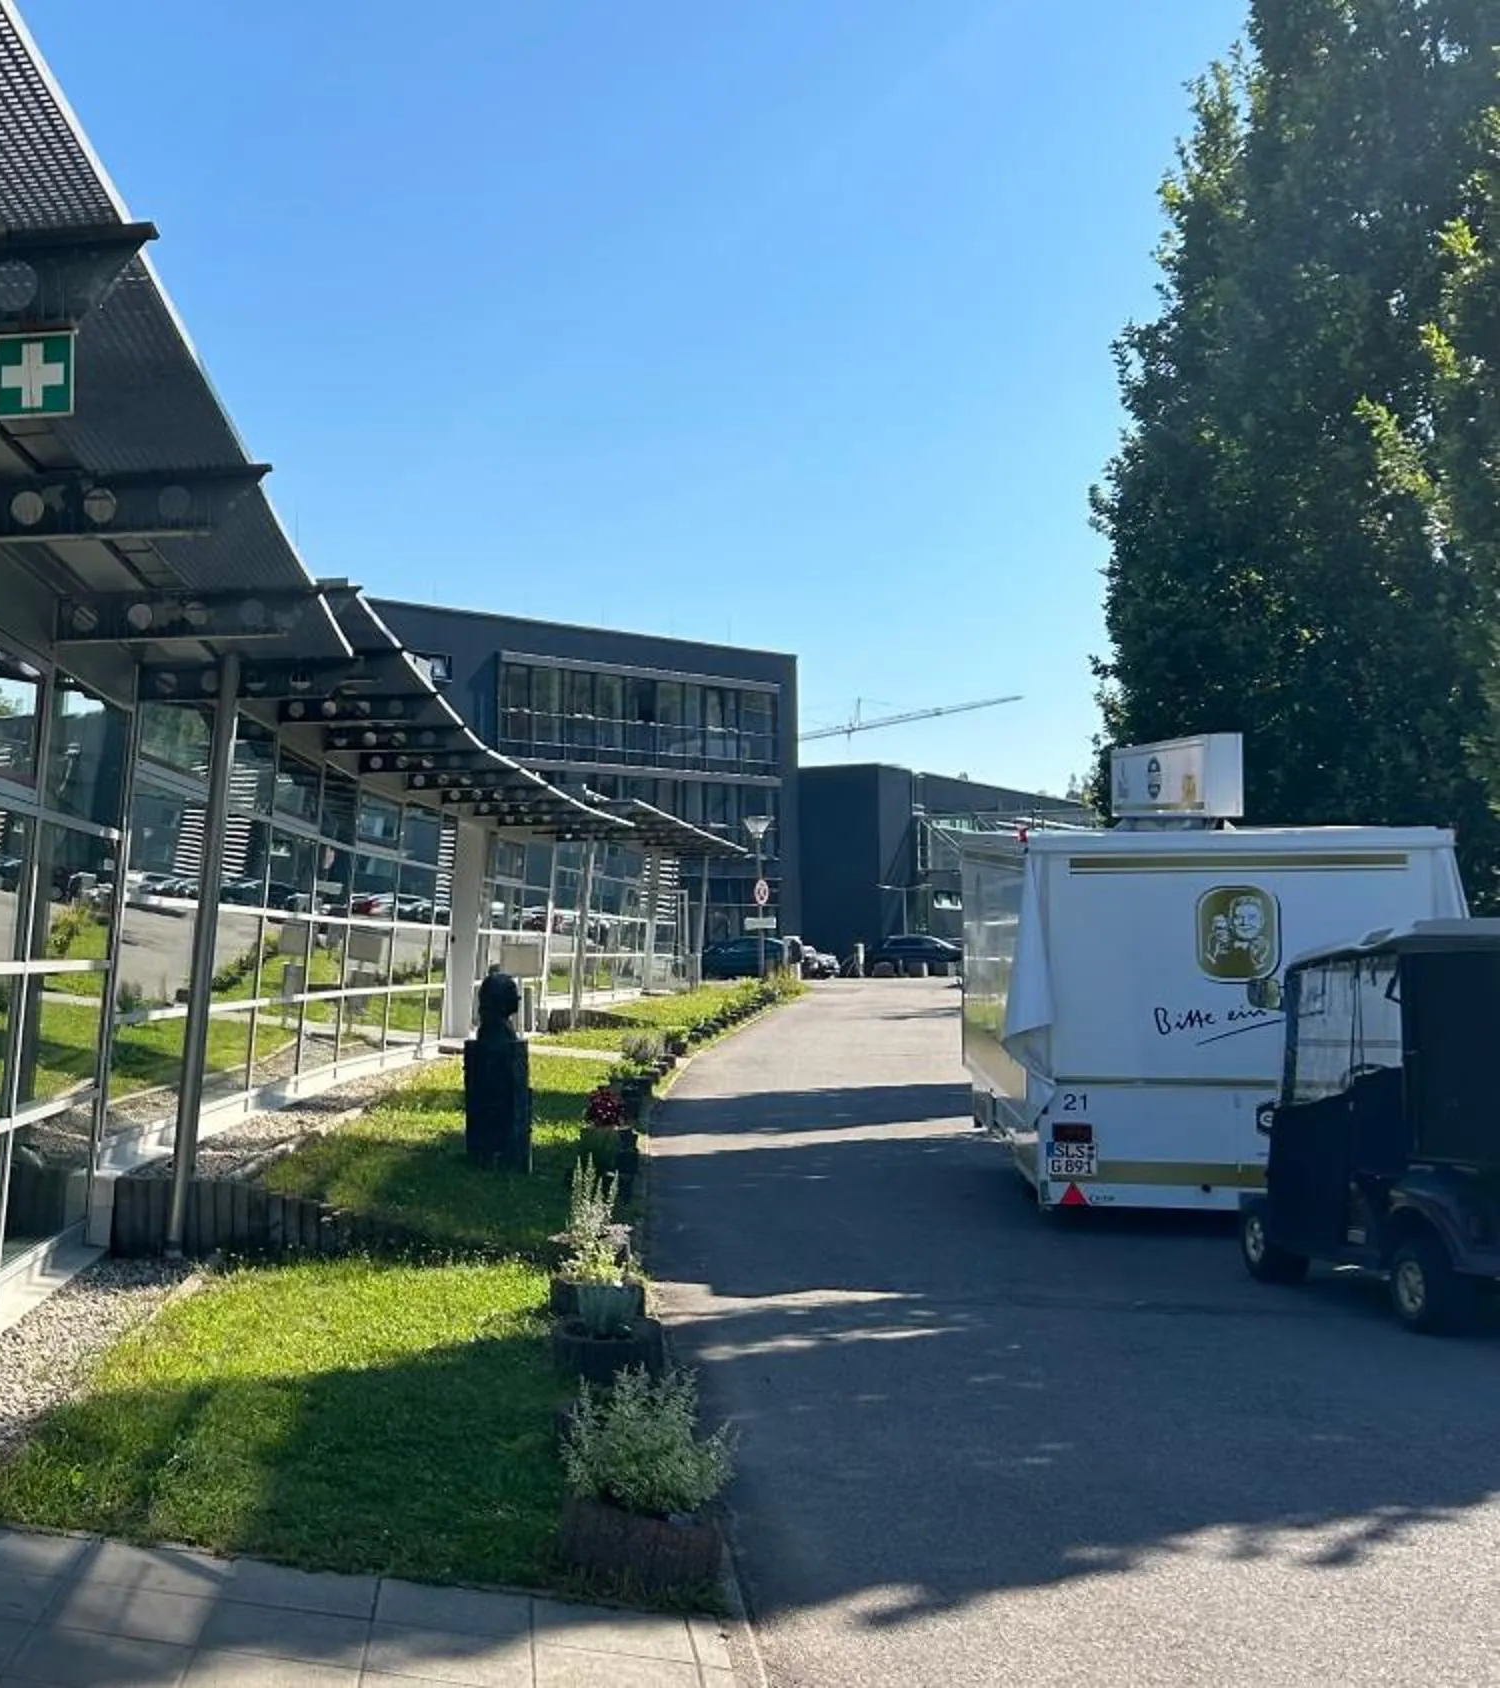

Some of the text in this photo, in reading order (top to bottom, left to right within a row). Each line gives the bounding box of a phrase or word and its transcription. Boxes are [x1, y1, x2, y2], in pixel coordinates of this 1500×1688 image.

[1153, 1006, 1217, 1036] Bitte
[1063, 1093, 1089, 1112] 21
[1053, 1144, 1086, 1159] SLS
